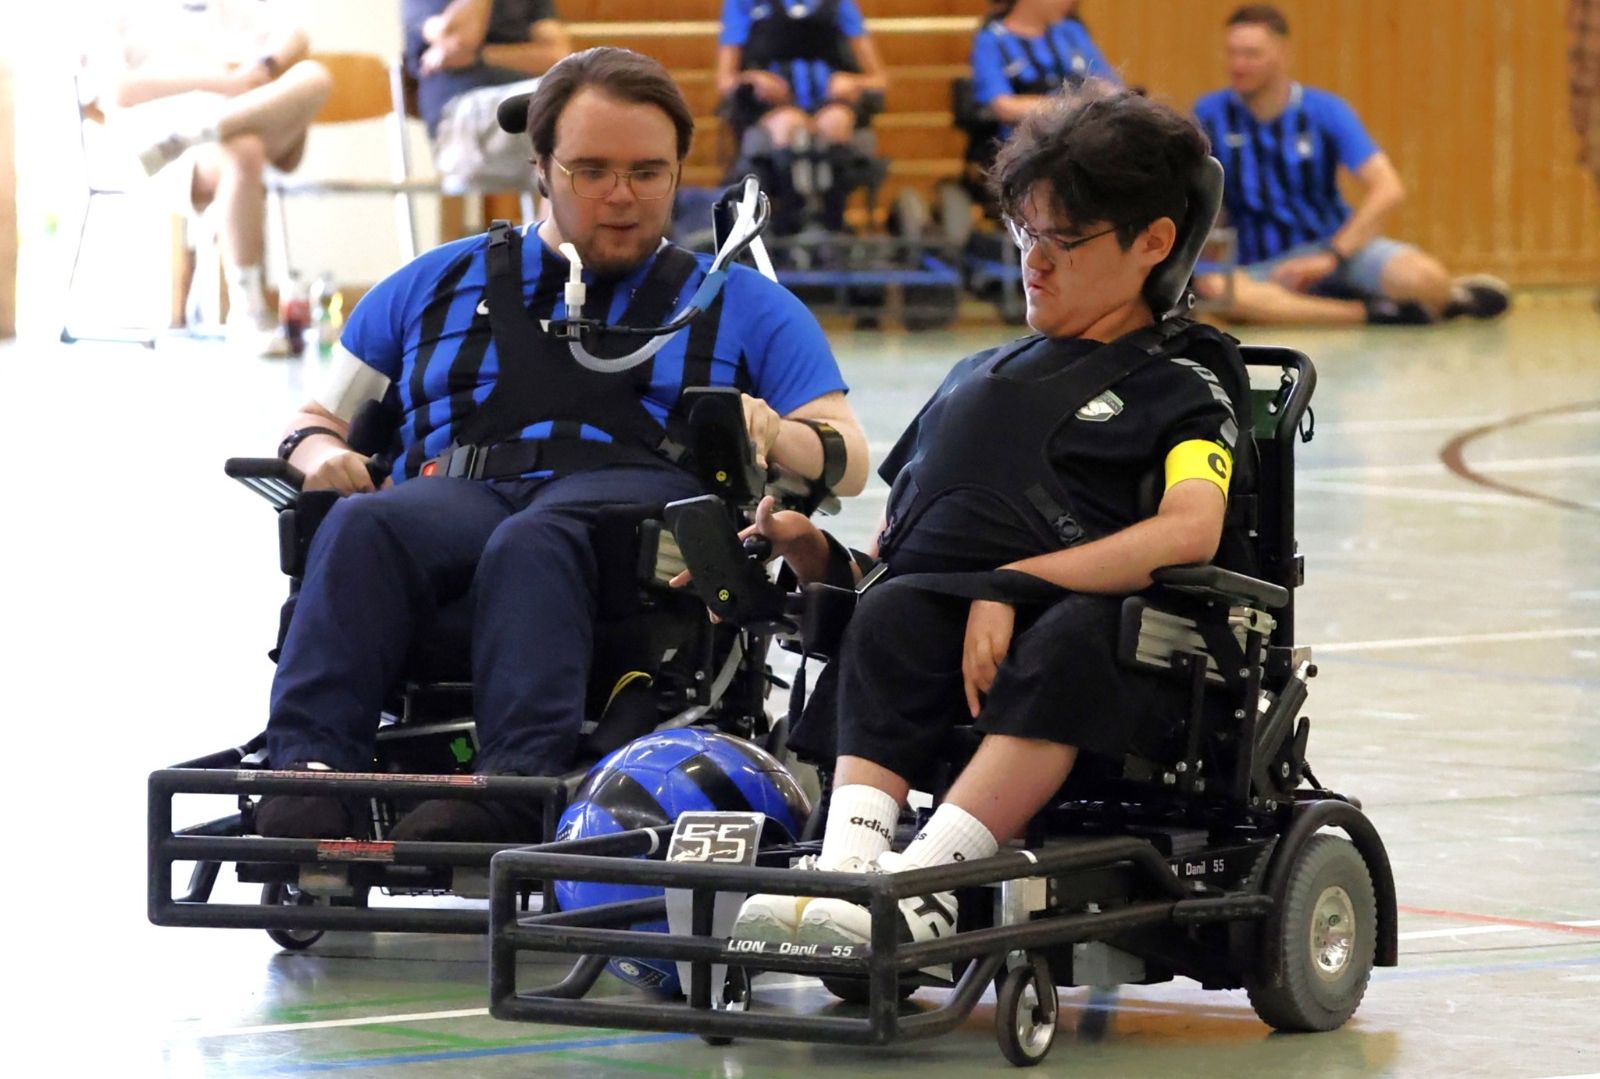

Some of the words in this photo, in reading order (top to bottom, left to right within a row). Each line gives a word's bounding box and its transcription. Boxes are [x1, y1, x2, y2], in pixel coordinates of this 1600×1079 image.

[1207, 453, 1227, 479] C
[680, 823, 750, 863] 55
[850, 816, 892, 846] adida
[1185, 861, 1206, 876] Danil
[1212, 859, 1225, 872] 55
[727, 939, 766, 953] LION
[779, 942, 818, 955] Danil
[831, 945, 854, 957] 55
